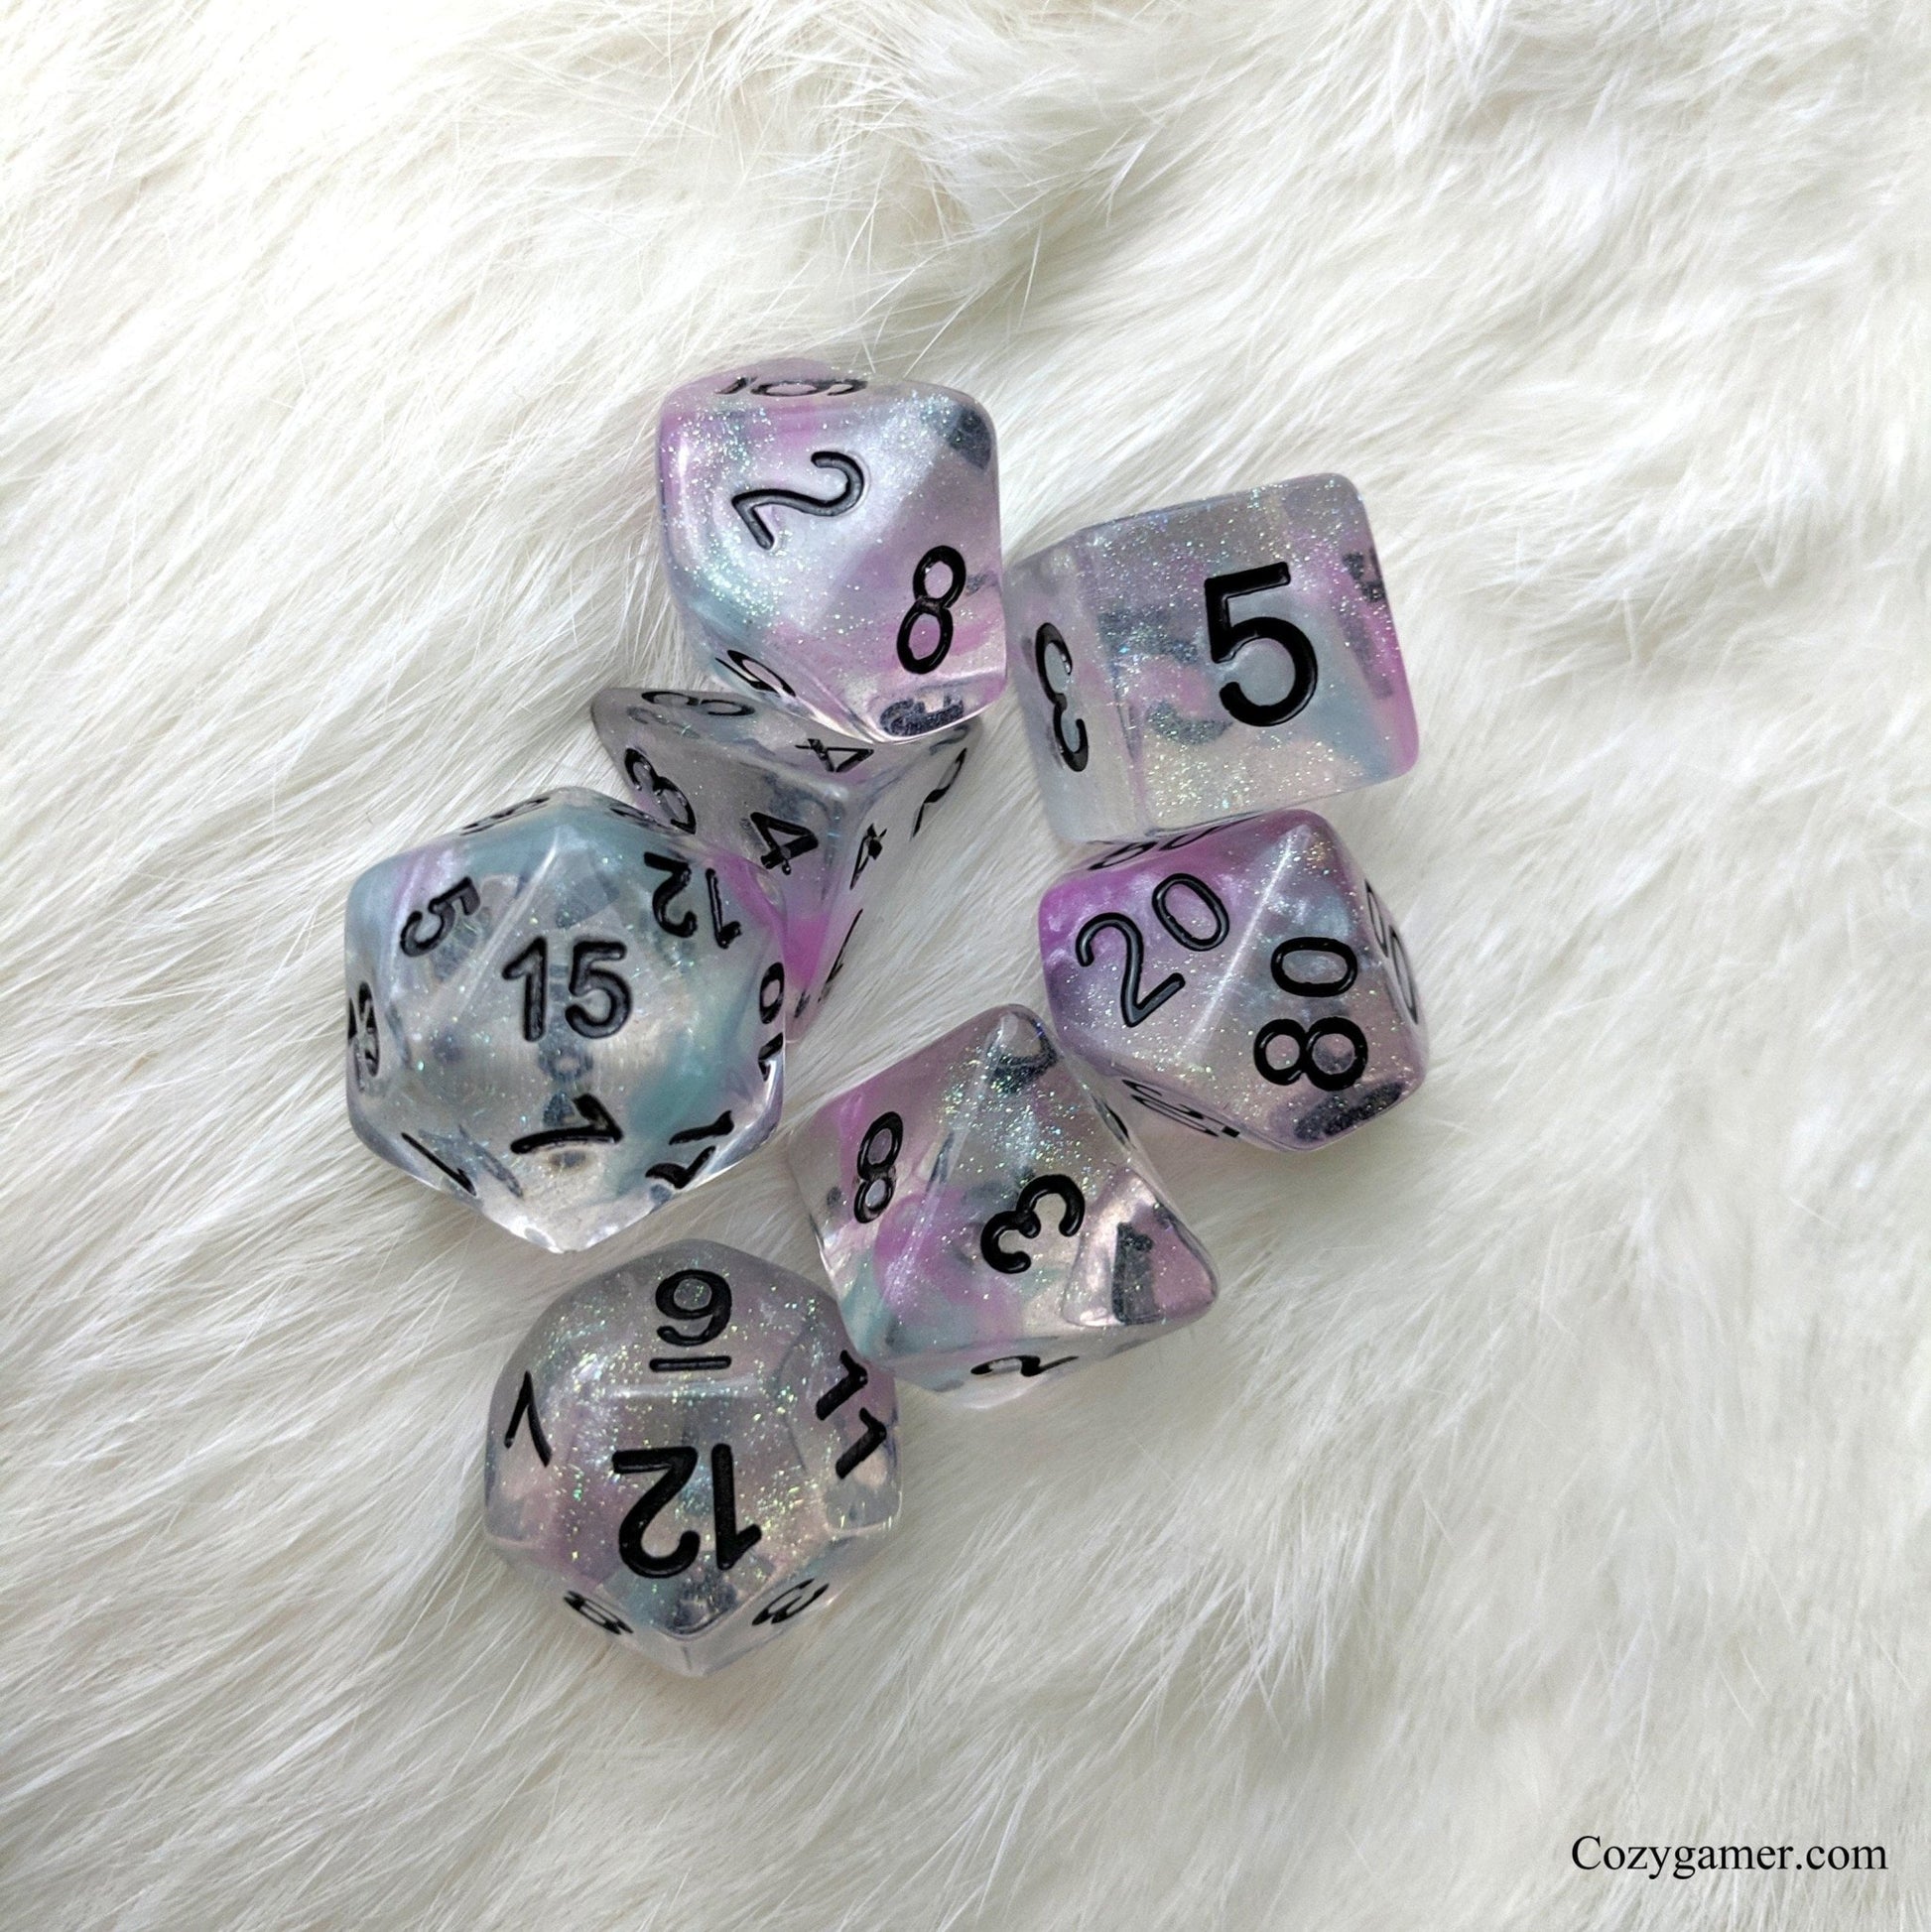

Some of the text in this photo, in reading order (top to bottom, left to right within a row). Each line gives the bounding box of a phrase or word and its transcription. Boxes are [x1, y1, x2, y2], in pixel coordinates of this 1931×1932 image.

[731, 450, 865, 551] 2
[897, 545, 966, 675] 8
[1204, 561, 1319, 727] 5
[1035, 622, 1090, 773] 3
[796, 738, 875, 773] 4
[750, 811, 820, 875] 4
[849, 824, 888, 891] 4
[399, 876, 482, 958] 5
[643, 850, 744, 950] 12
[1075, 872, 1230, 1028] 20
[501, 936, 634, 1043] 15
[1252, 936, 1369, 1092] 80
[510, 1093, 624, 1155] 7
[853, 1110, 904, 1224] 8
[979, 1174, 1086, 1274] 3
[654, 1268, 733, 1348] 9
[504, 1370, 553, 1468] 7
[816, 1350, 888, 1481] 11
[611, 1443, 762, 1580] 12
